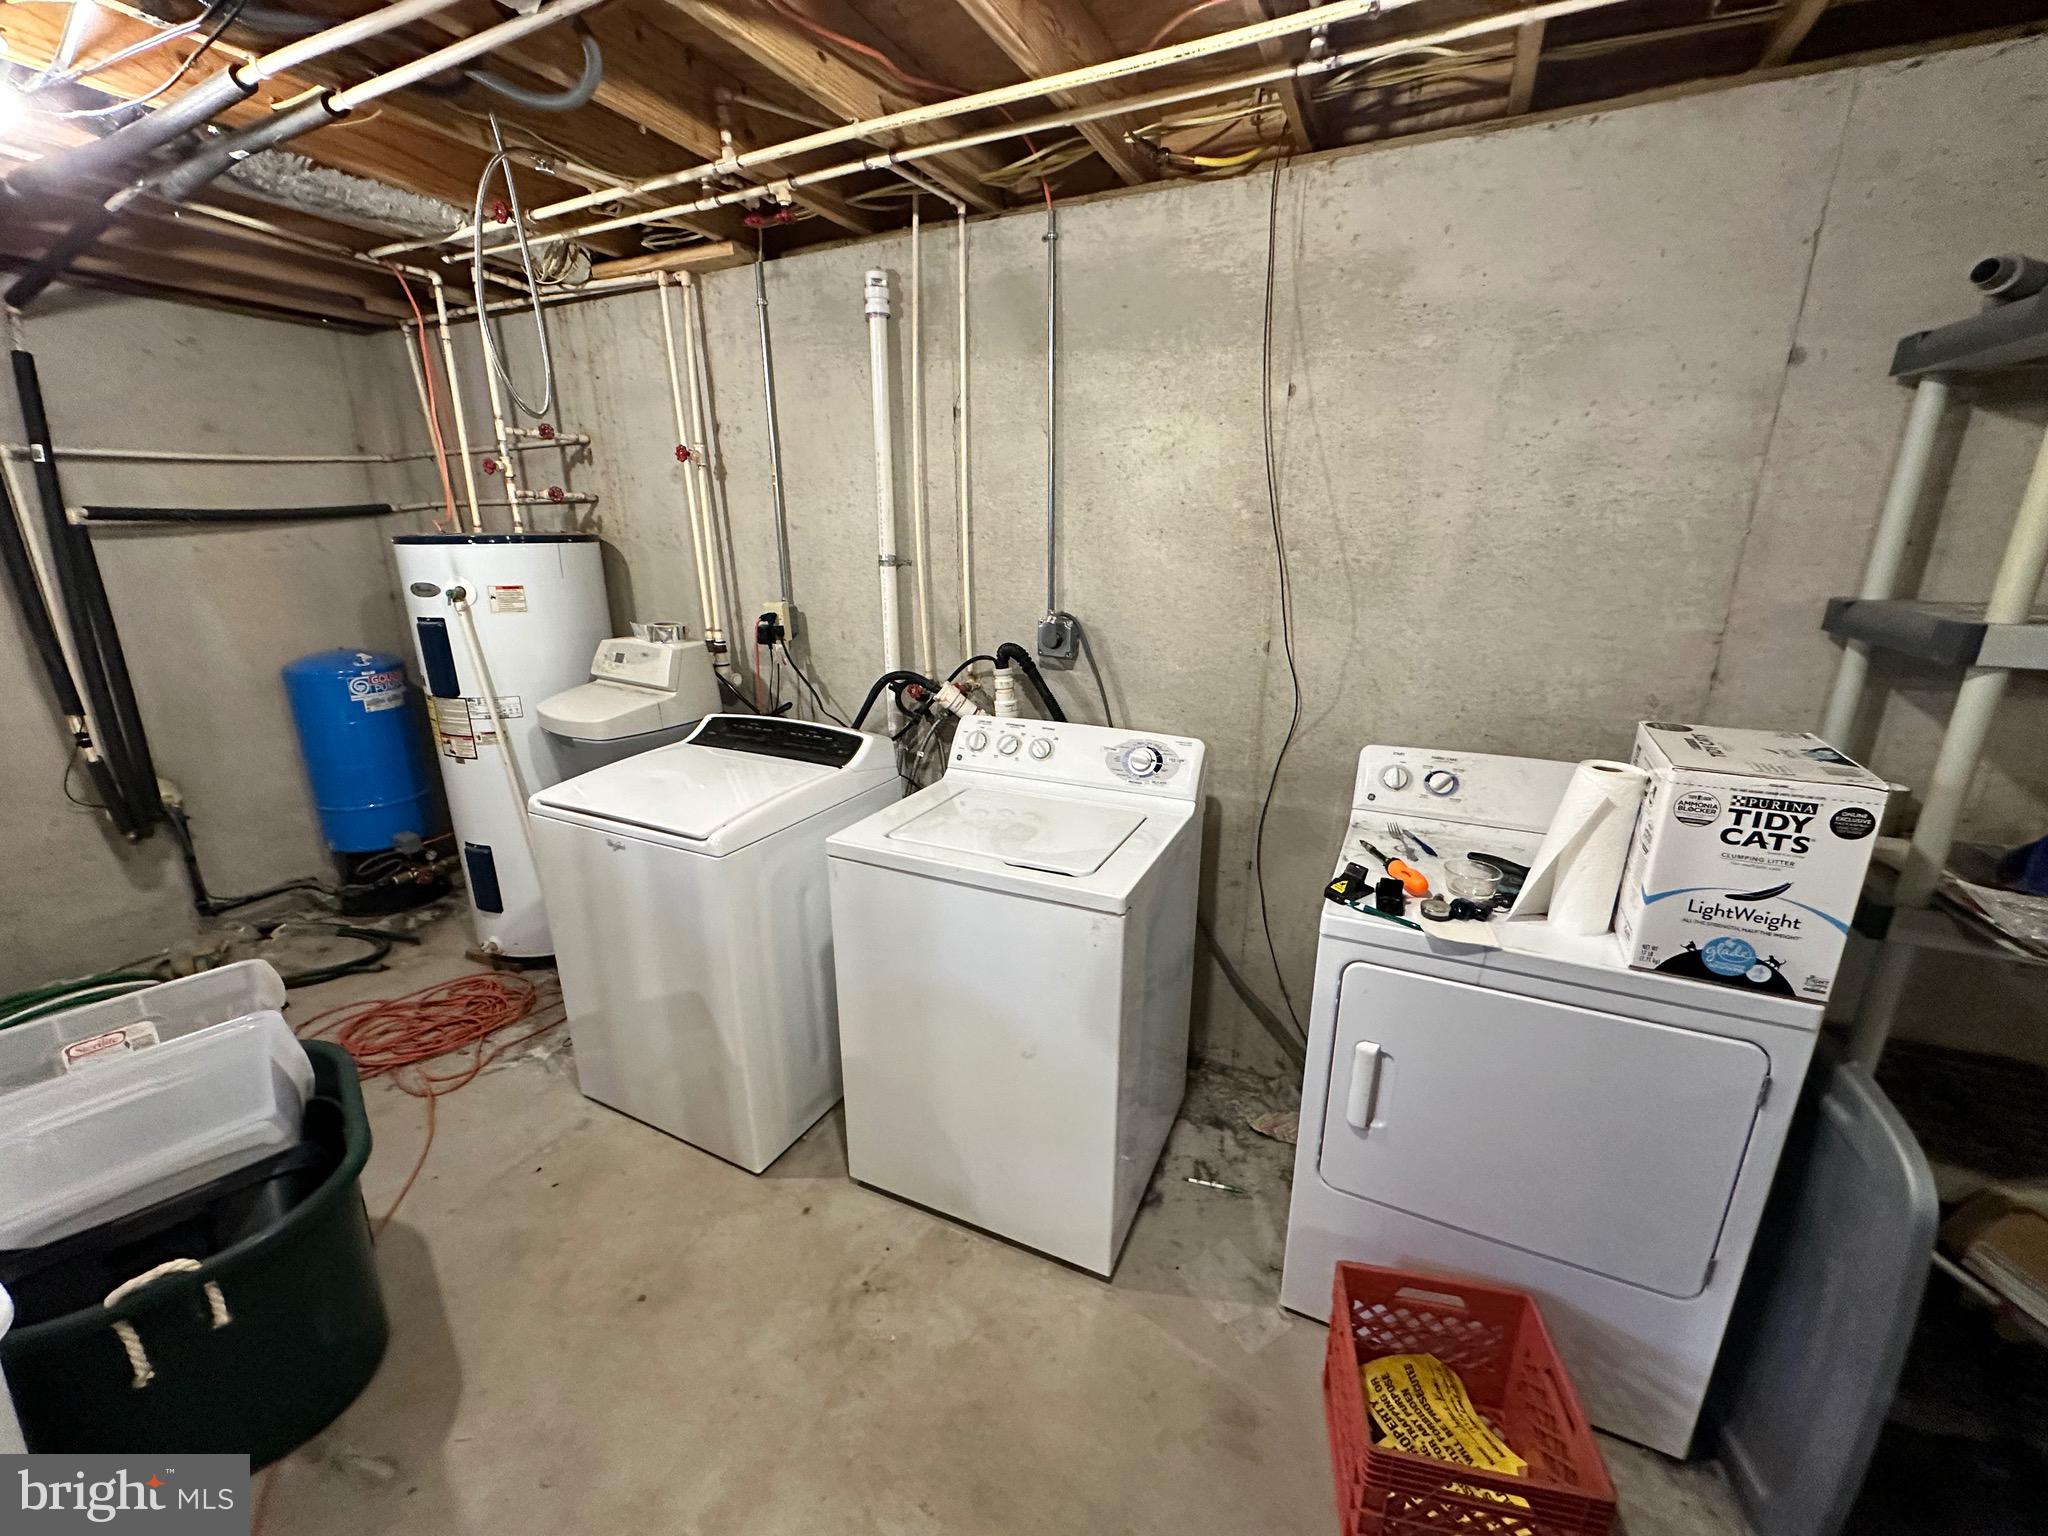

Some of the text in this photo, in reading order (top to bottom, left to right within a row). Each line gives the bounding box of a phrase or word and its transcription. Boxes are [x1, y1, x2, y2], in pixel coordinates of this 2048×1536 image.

[1677, 800, 1719, 810] AMMONIA
[1677, 805, 1717, 815] BLOCKER
[1748, 798, 1815, 814] PURINA
[1728, 807, 1815, 833] TIDY
[1835, 816, 1872, 825] EXCLUSIVE
[1841, 811, 1868, 819] ONLINE
[1720, 827, 1811, 854] CATS
[1721, 852, 1765, 863] CLUMPING
[1767, 857, 1796, 867] LITTER
[1687, 898, 1803, 932] LightWeight
[1371, 1377, 1382, 1392] OR
[1380, 1394, 1419, 1441] TRAPPING
[1381, 1371, 1446, 1460] FOR ANY PURPOSE
[1401, 1388, 1445, 1442] FORBIDDEN
[1440, 1423, 1454, 1438] BE
[1454, 1440, 1474, 1465] WILL
